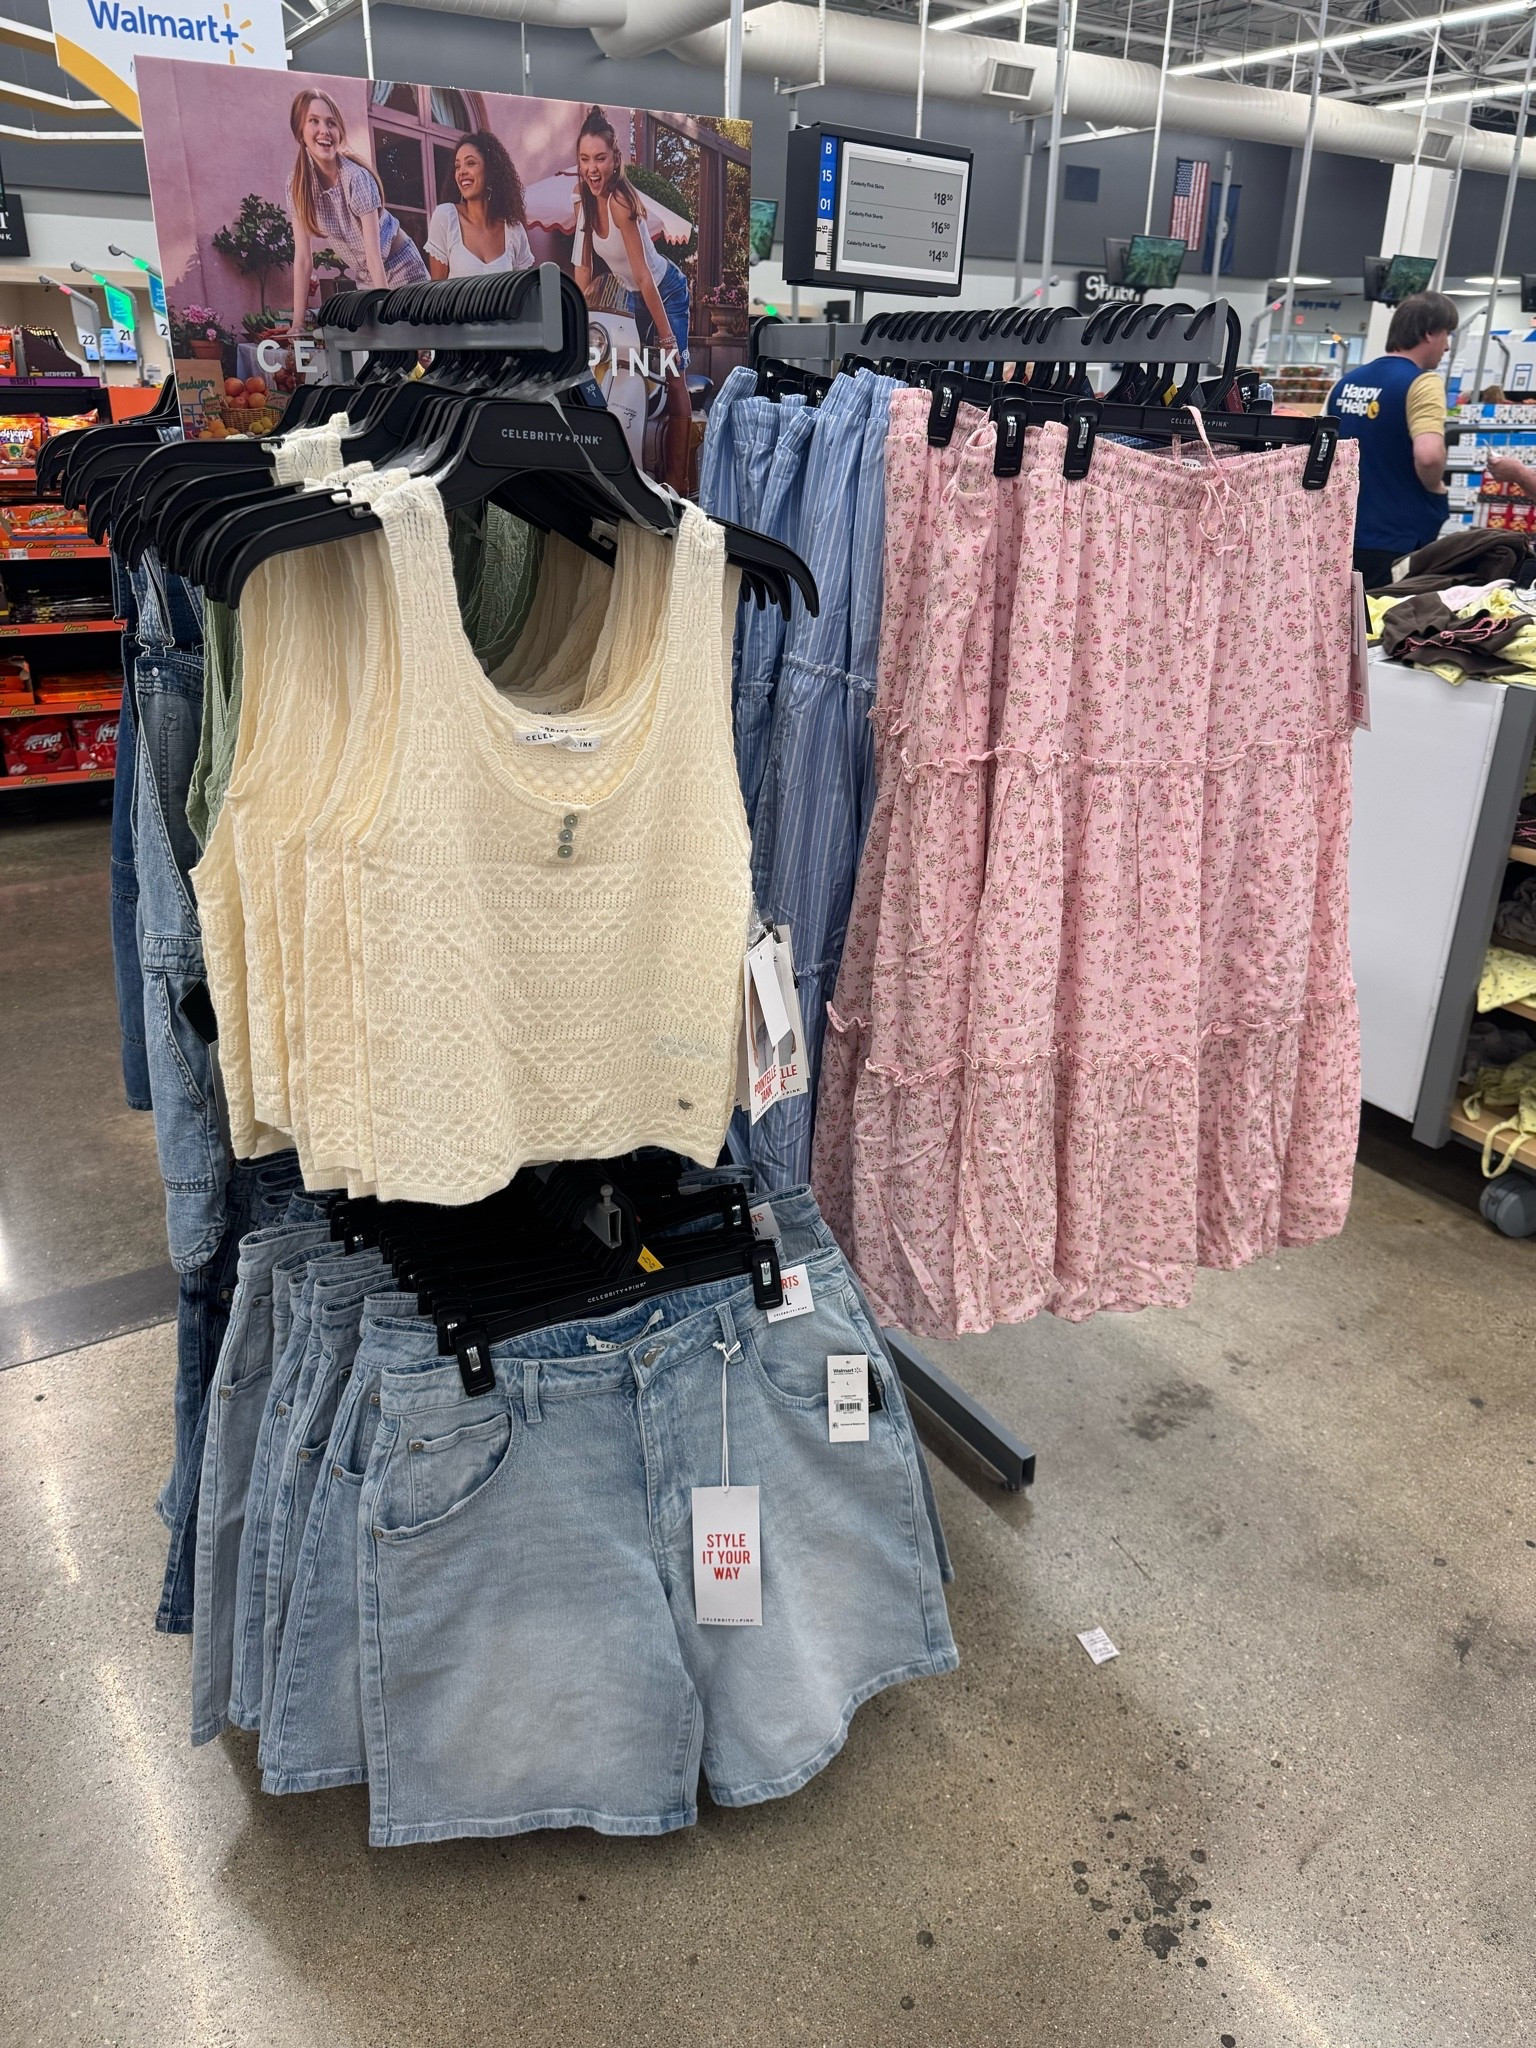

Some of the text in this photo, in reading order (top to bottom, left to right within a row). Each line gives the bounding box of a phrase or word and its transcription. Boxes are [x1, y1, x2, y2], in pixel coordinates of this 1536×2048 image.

[825, 142, 832, 154] B
[821, 169, 832, 182] 15
[850, 180, 866, 188] Celebrity
[820, 198, 831, 211] 01
[848, 210, 864, 218] Celebrity
[846, 240, 862, 248] Celebrity
[81, 335, 95, 345] 22
[119, 329, 131, 341] 21
[1341, 383, 1382, 401] Happy
[1341, 399, 1370, 416] Help
[501, 428, 600, 445] CELEBRITY PINK
[587, 1288, 624, 1303] CELEBRITY
[706, 1533, 747, 1548] STYLE
[702, 1550, 751, 1565] IT YOUR
[713, 1566, 741, 1581] WAY
